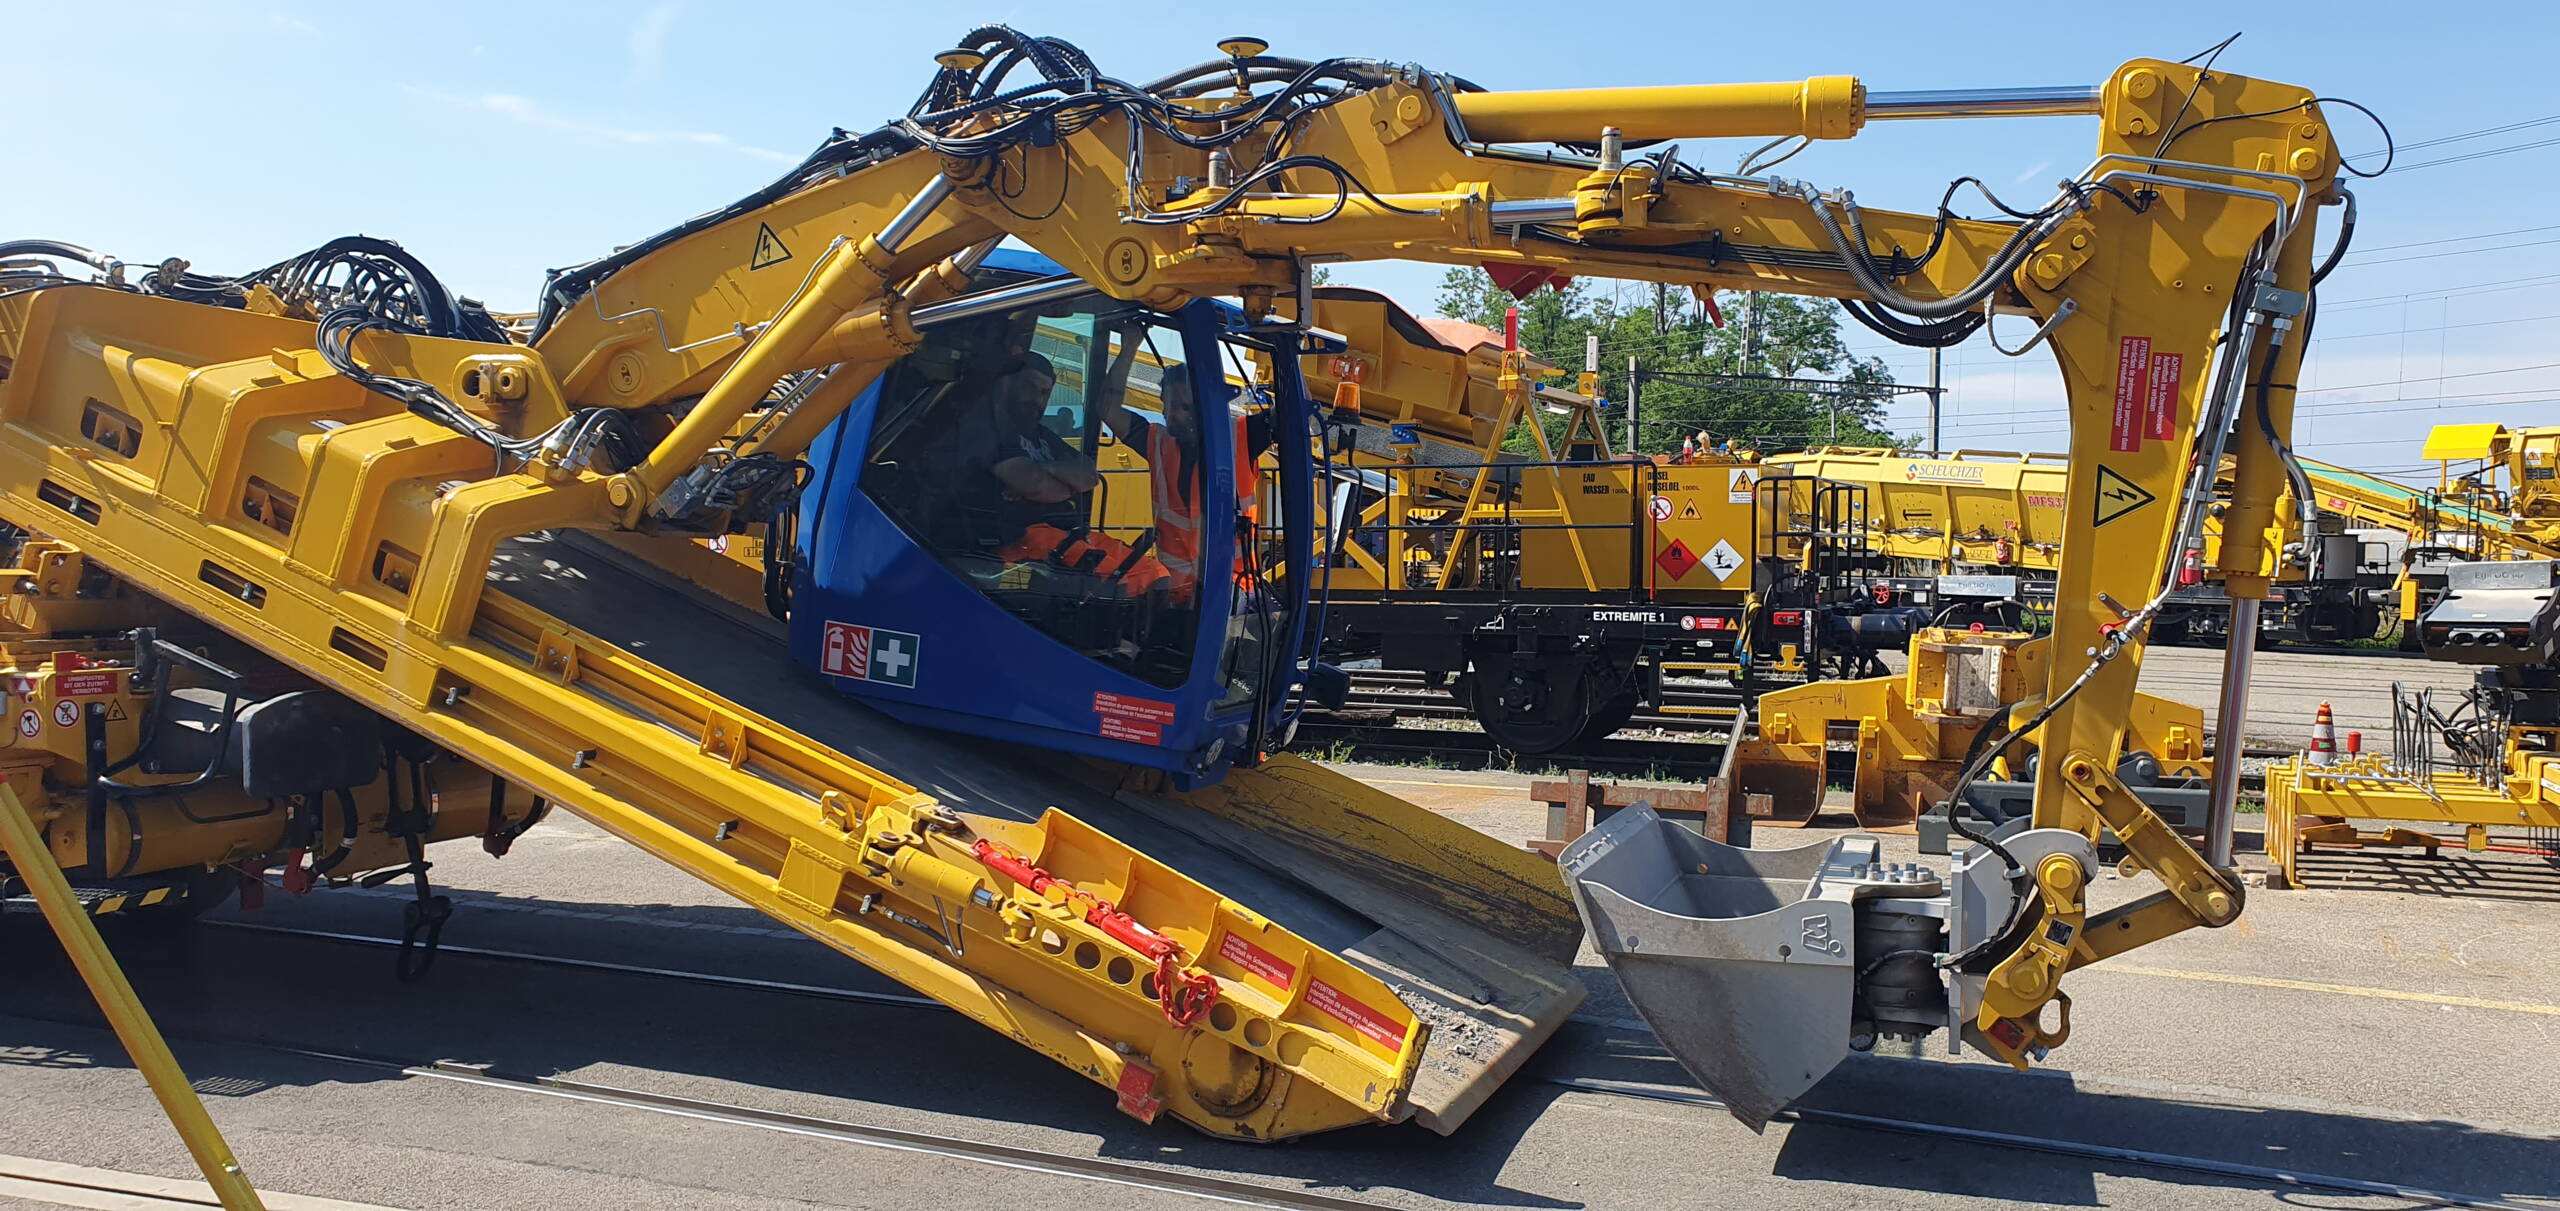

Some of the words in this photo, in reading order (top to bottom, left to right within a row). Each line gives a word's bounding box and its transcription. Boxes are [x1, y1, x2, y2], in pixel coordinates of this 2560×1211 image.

[1647, 471, 1669, 481] DSEL
[1919, 463, 1984, 479] SCHEUCHZER
[1583, 473, 1595, 482] EAU
[1583, 485, 1609, 495] WASSER
[1647, 482, 1680, 491] DSELOEL
[1593, 611, 1656, 622] EXTREMITE
[1659, 612, 1665, 622] 1
